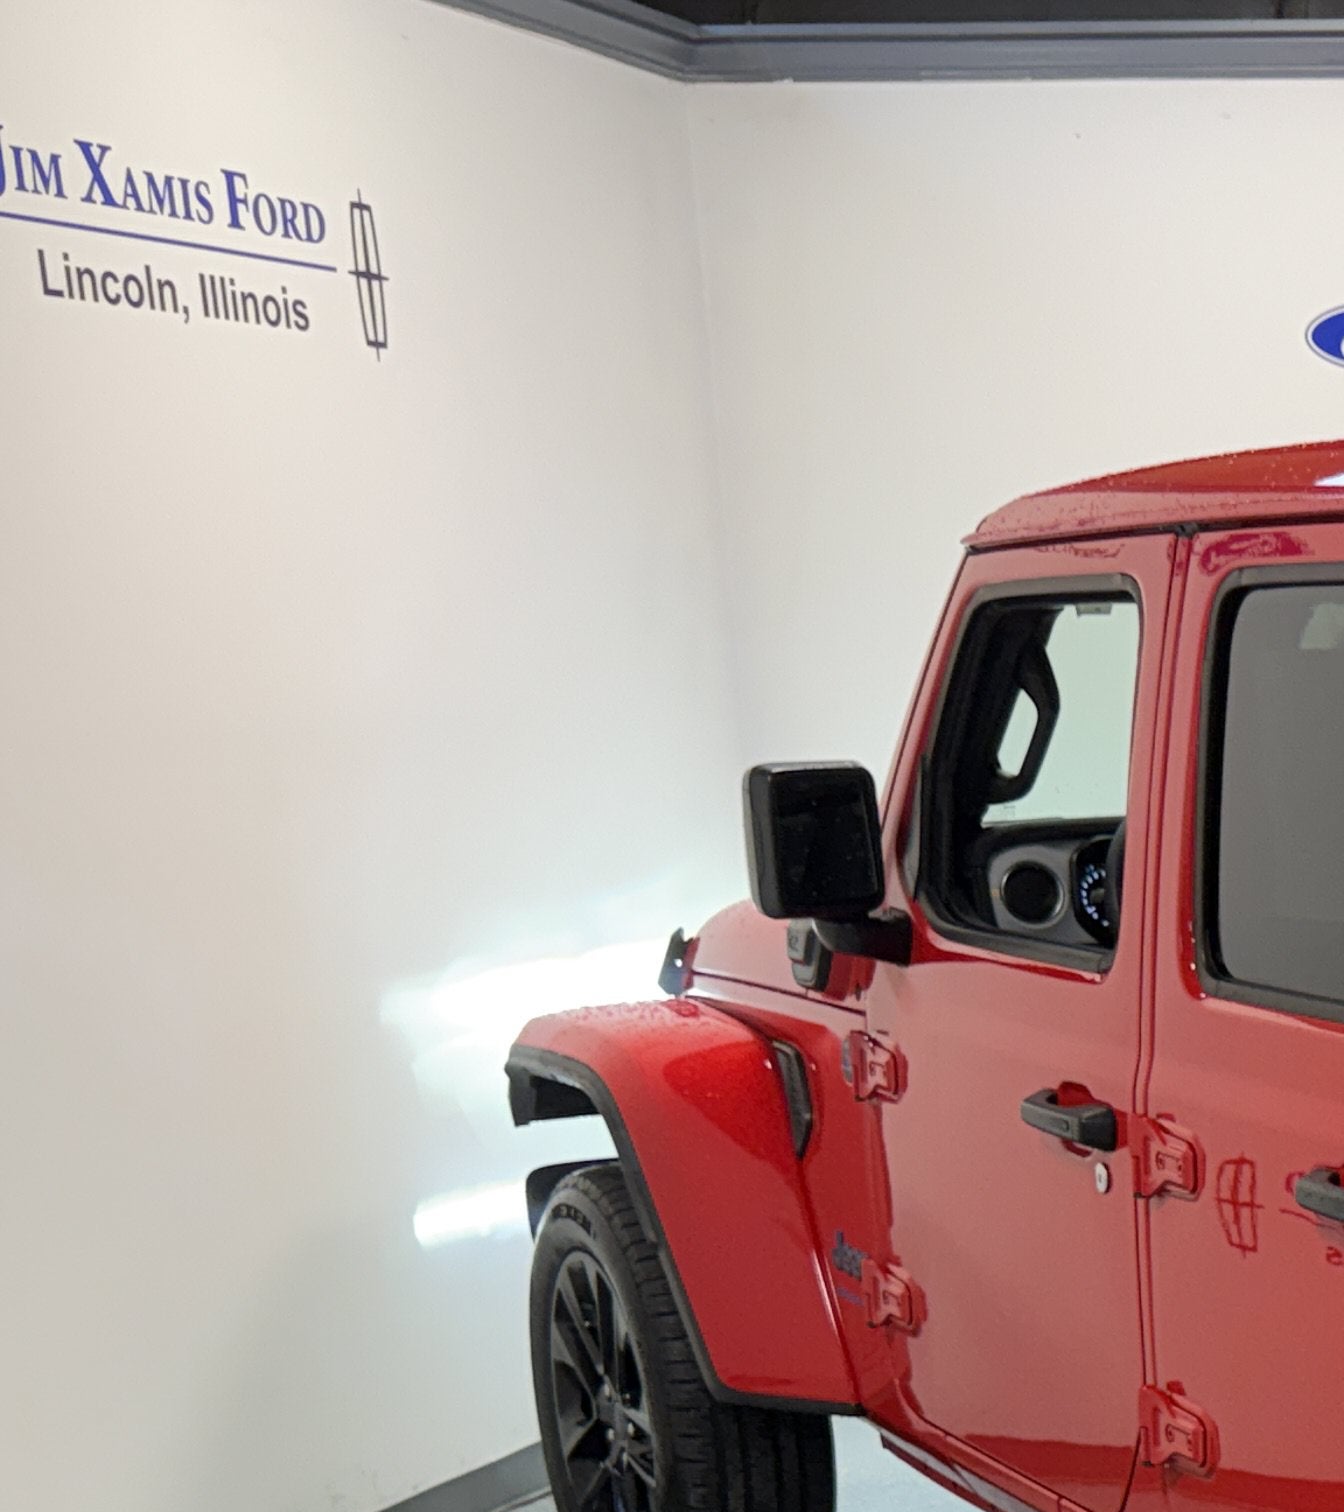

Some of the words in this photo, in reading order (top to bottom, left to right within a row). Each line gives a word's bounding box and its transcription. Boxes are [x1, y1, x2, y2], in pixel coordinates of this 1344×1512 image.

[73, 138, 215, 225] XAMIS
[220, 168, 326, 244] FORD
[37, 248, 191, 324] Lincoln,
[199, 272, 310, 332] Illinois
